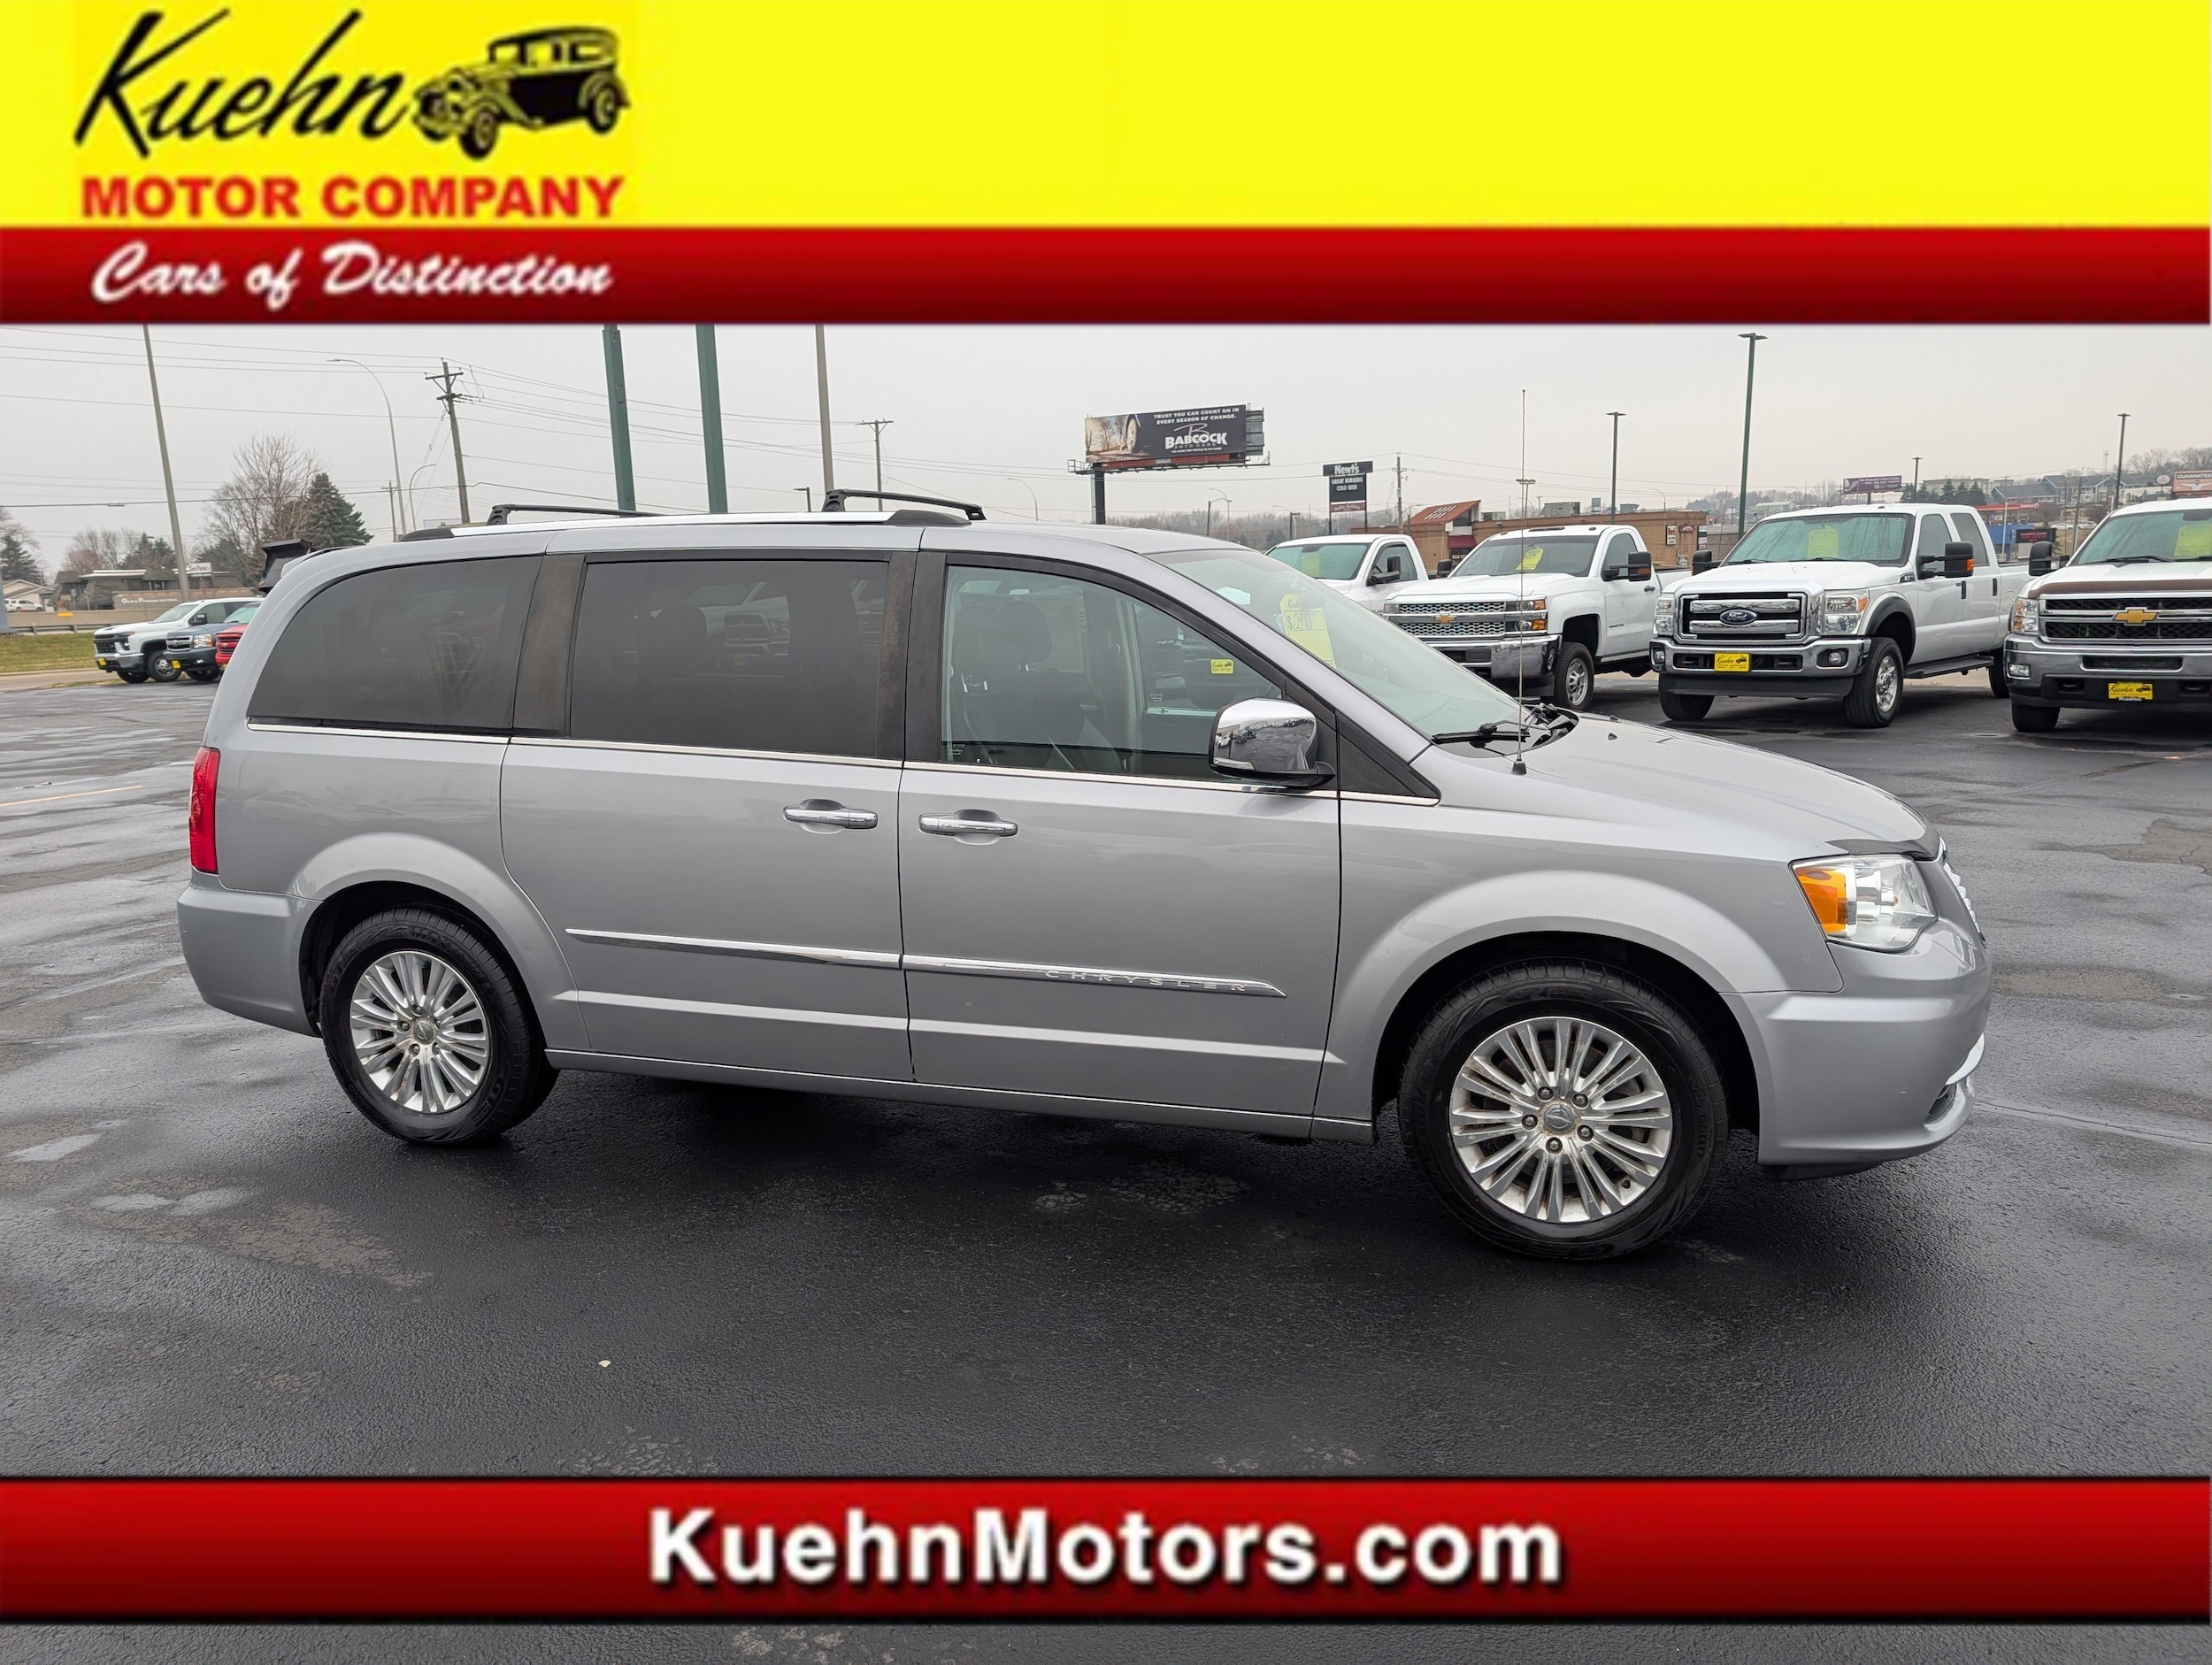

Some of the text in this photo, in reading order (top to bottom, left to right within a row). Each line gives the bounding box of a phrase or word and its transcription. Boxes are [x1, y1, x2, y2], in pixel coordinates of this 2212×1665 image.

[1164, 433, 1228, 449] BABCOCK
[1334, 463, 1360, 475] Newt's
[1727, 611, 1747, 621] Ford
[1044, 970, 1246, 993] CHRYSLER
